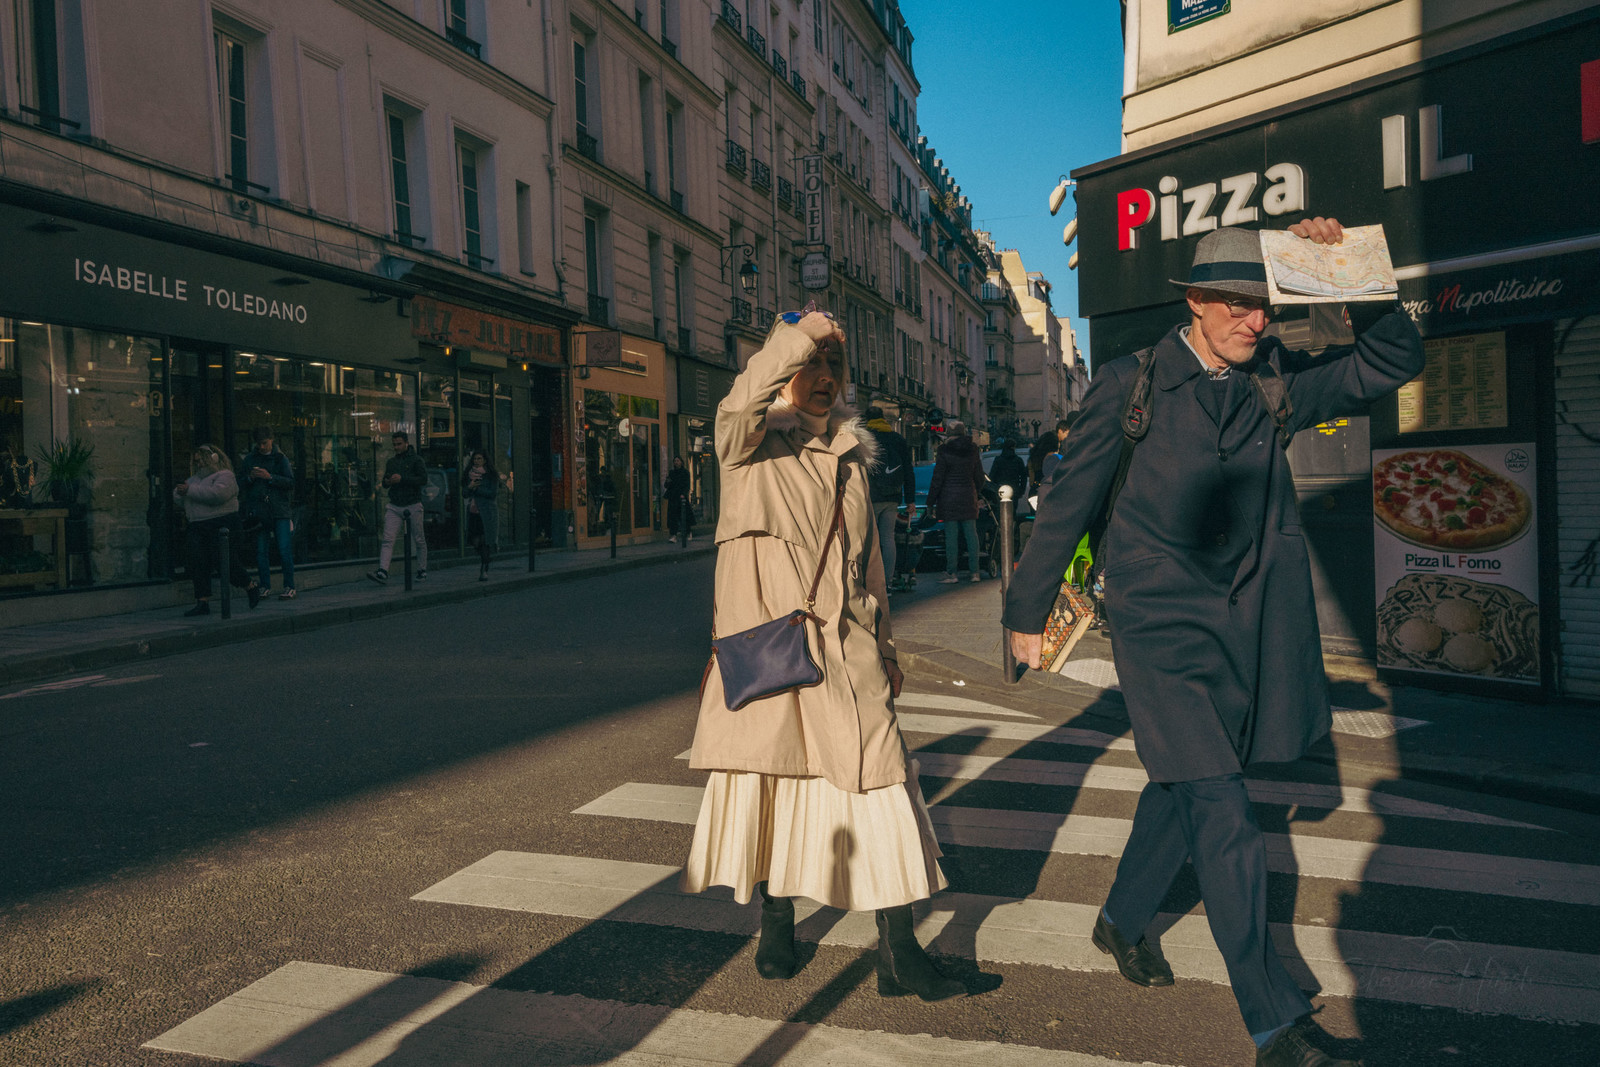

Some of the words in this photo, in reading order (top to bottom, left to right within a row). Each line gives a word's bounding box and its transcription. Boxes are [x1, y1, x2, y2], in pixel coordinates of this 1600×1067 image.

[805, 158, 821, 242] HOTEL
[1117, 162, 1305, 251] Pizza
[75, 257, 188, 302] ISABELLE
[203, 285, 308, 324] TOLEDANO
[1402, 298, 1433, 322] zza
[1405, 553, 1439, 568] Pizza
[1442, 555, 1455, 568] IL
[1458, 555, 1502, 570] Forno
[1393, 581, 1511, 615] PIZZA
